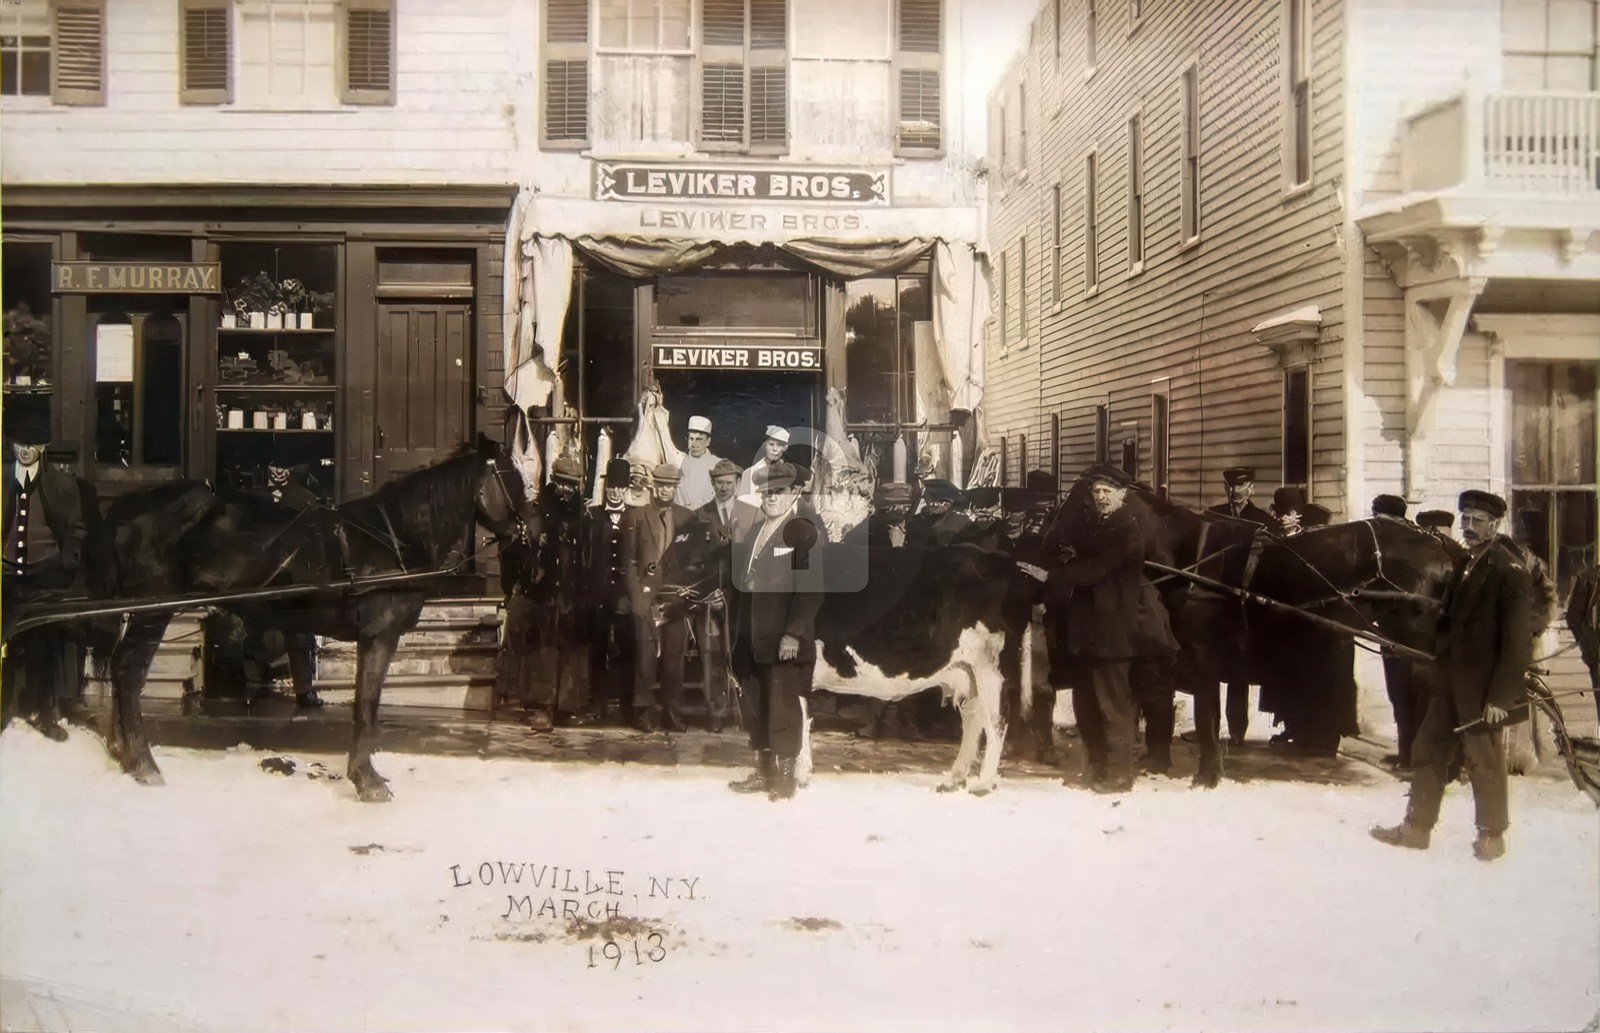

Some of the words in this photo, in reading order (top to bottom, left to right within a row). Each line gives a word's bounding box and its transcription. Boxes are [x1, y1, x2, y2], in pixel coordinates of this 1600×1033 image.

[626, 171, 756, 196] LEVIKER
[769, 174, 860, 199] BROS.
[640, 209, 767, 230] LEVIKER
[782, 214, 869, 231] BROS.
[658, 348, 749, 366] LEVIKER
[757, 350, 821, 368] BROS.
[501, 895, 621, 932] MARCH
[586, 932, 667, 971] 1913
